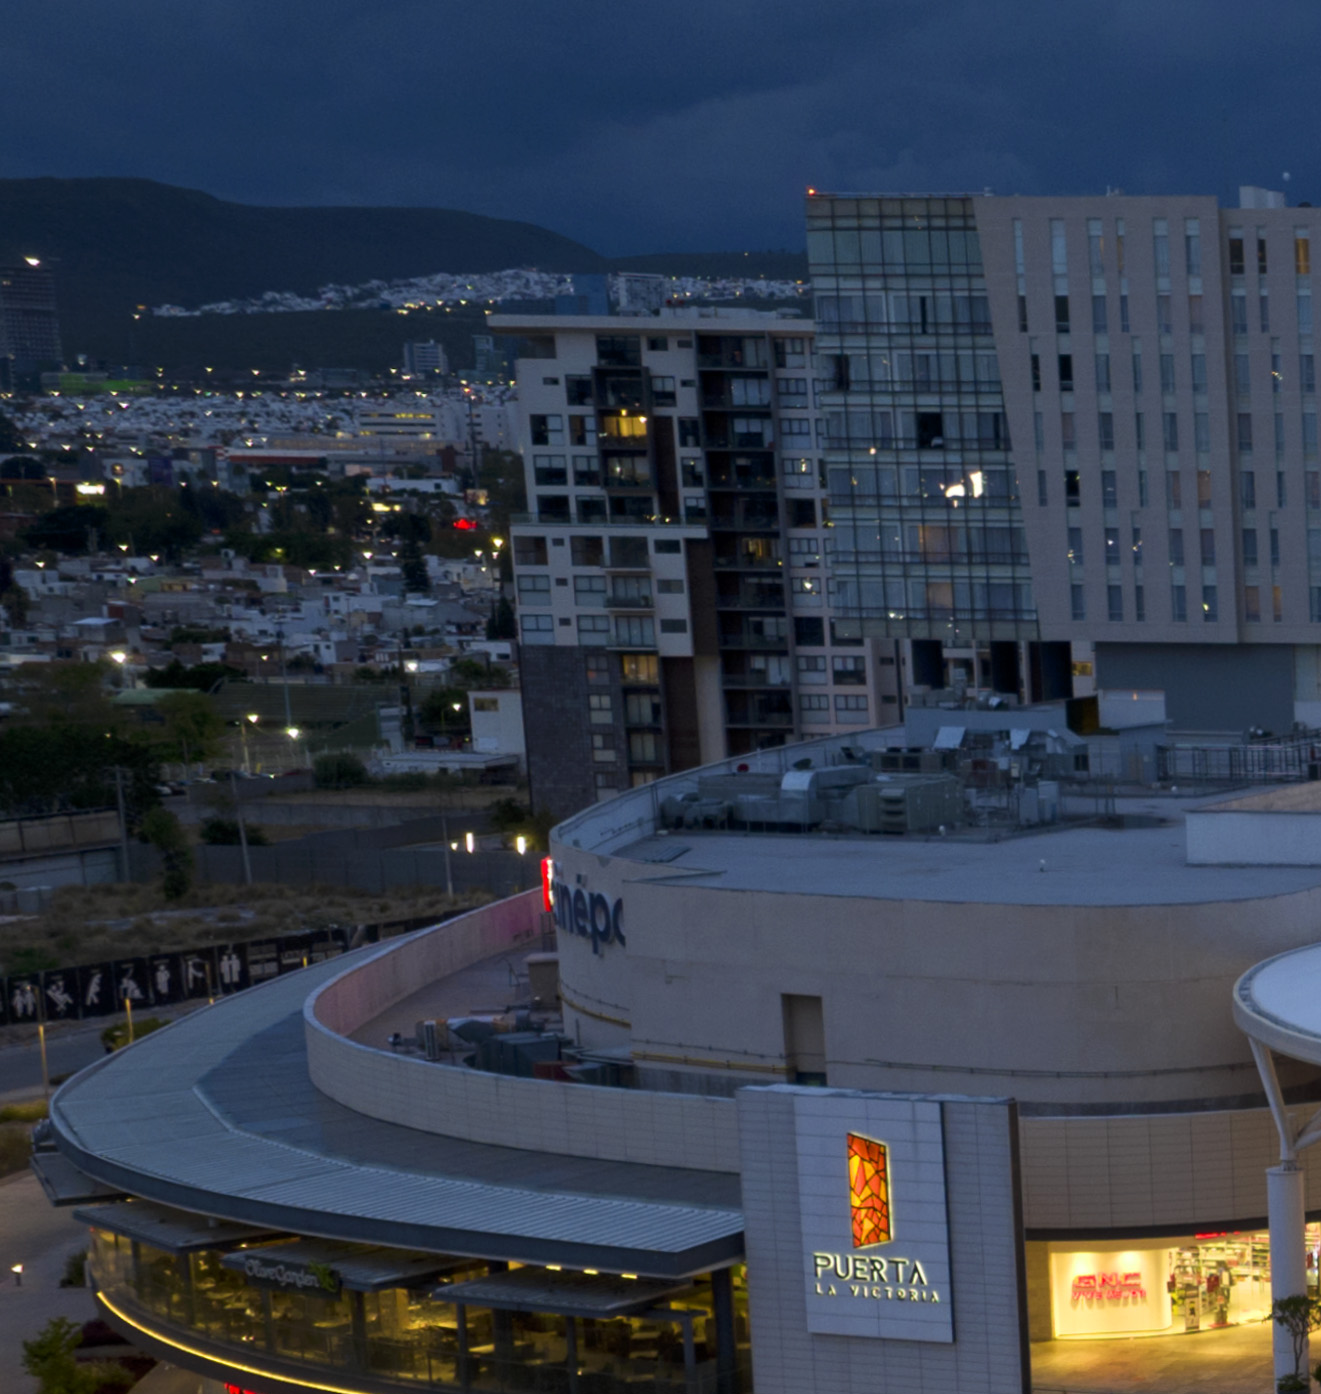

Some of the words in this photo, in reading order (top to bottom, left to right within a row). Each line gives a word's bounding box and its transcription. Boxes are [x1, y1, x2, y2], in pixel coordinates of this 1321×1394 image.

[813, 1251, 928, 1286] PUERTA
[1073, 1272, 1142, 1288] GNC
[816, 1283, 837, 1296] LA
[850, 1285, 940, 1303] VICTORIA
